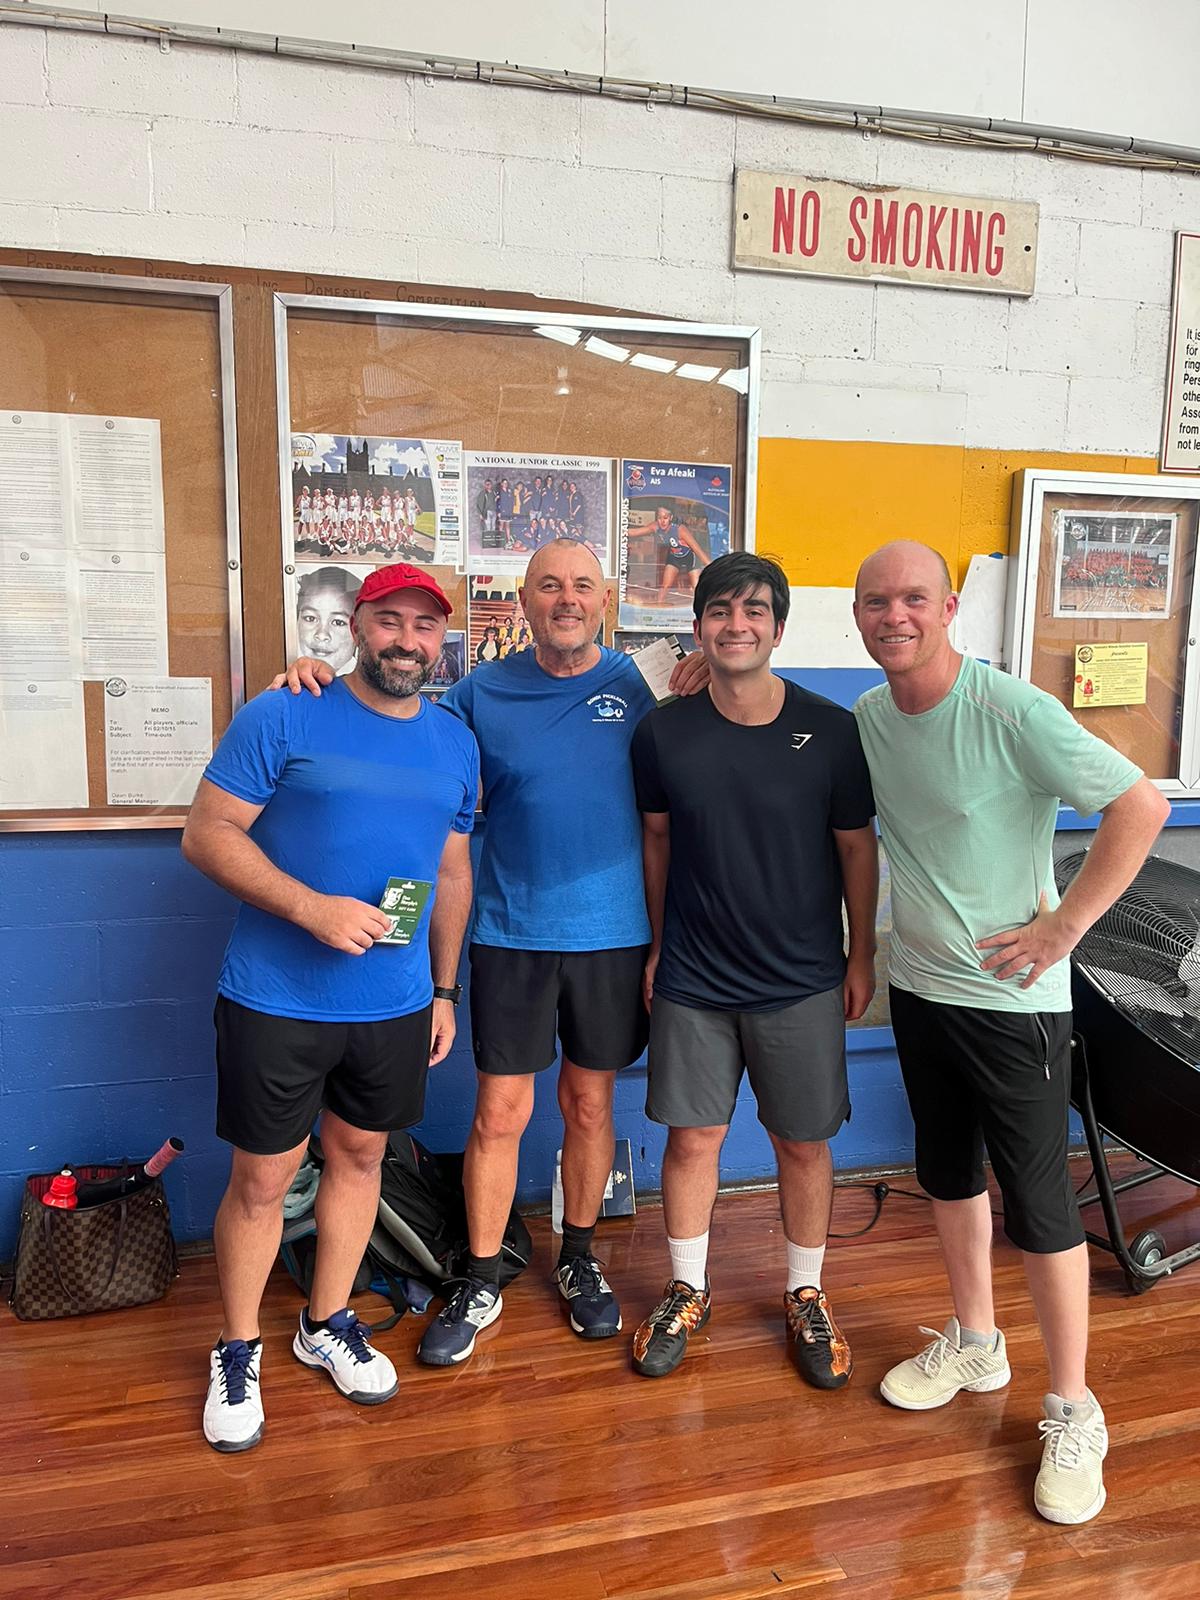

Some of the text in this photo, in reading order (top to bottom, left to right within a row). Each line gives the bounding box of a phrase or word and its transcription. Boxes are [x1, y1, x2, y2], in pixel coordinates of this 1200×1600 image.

[772, 187, 1005, 277] NO SMOKING
[1186, 328, 1193, 340] It
[1186, 344, 1199, 356] for
[1179, 422, 1199, 435] from
[1177, 439, 1192, 450] not
[474, 456, 600, 468] NATIONAL JUNIOR CLASSIC 1999
[650, 466, 665, 476] Eva
[667, 467, 696, 478] Afeaki
[620, 498, 630, 571] AMBASSADORS
